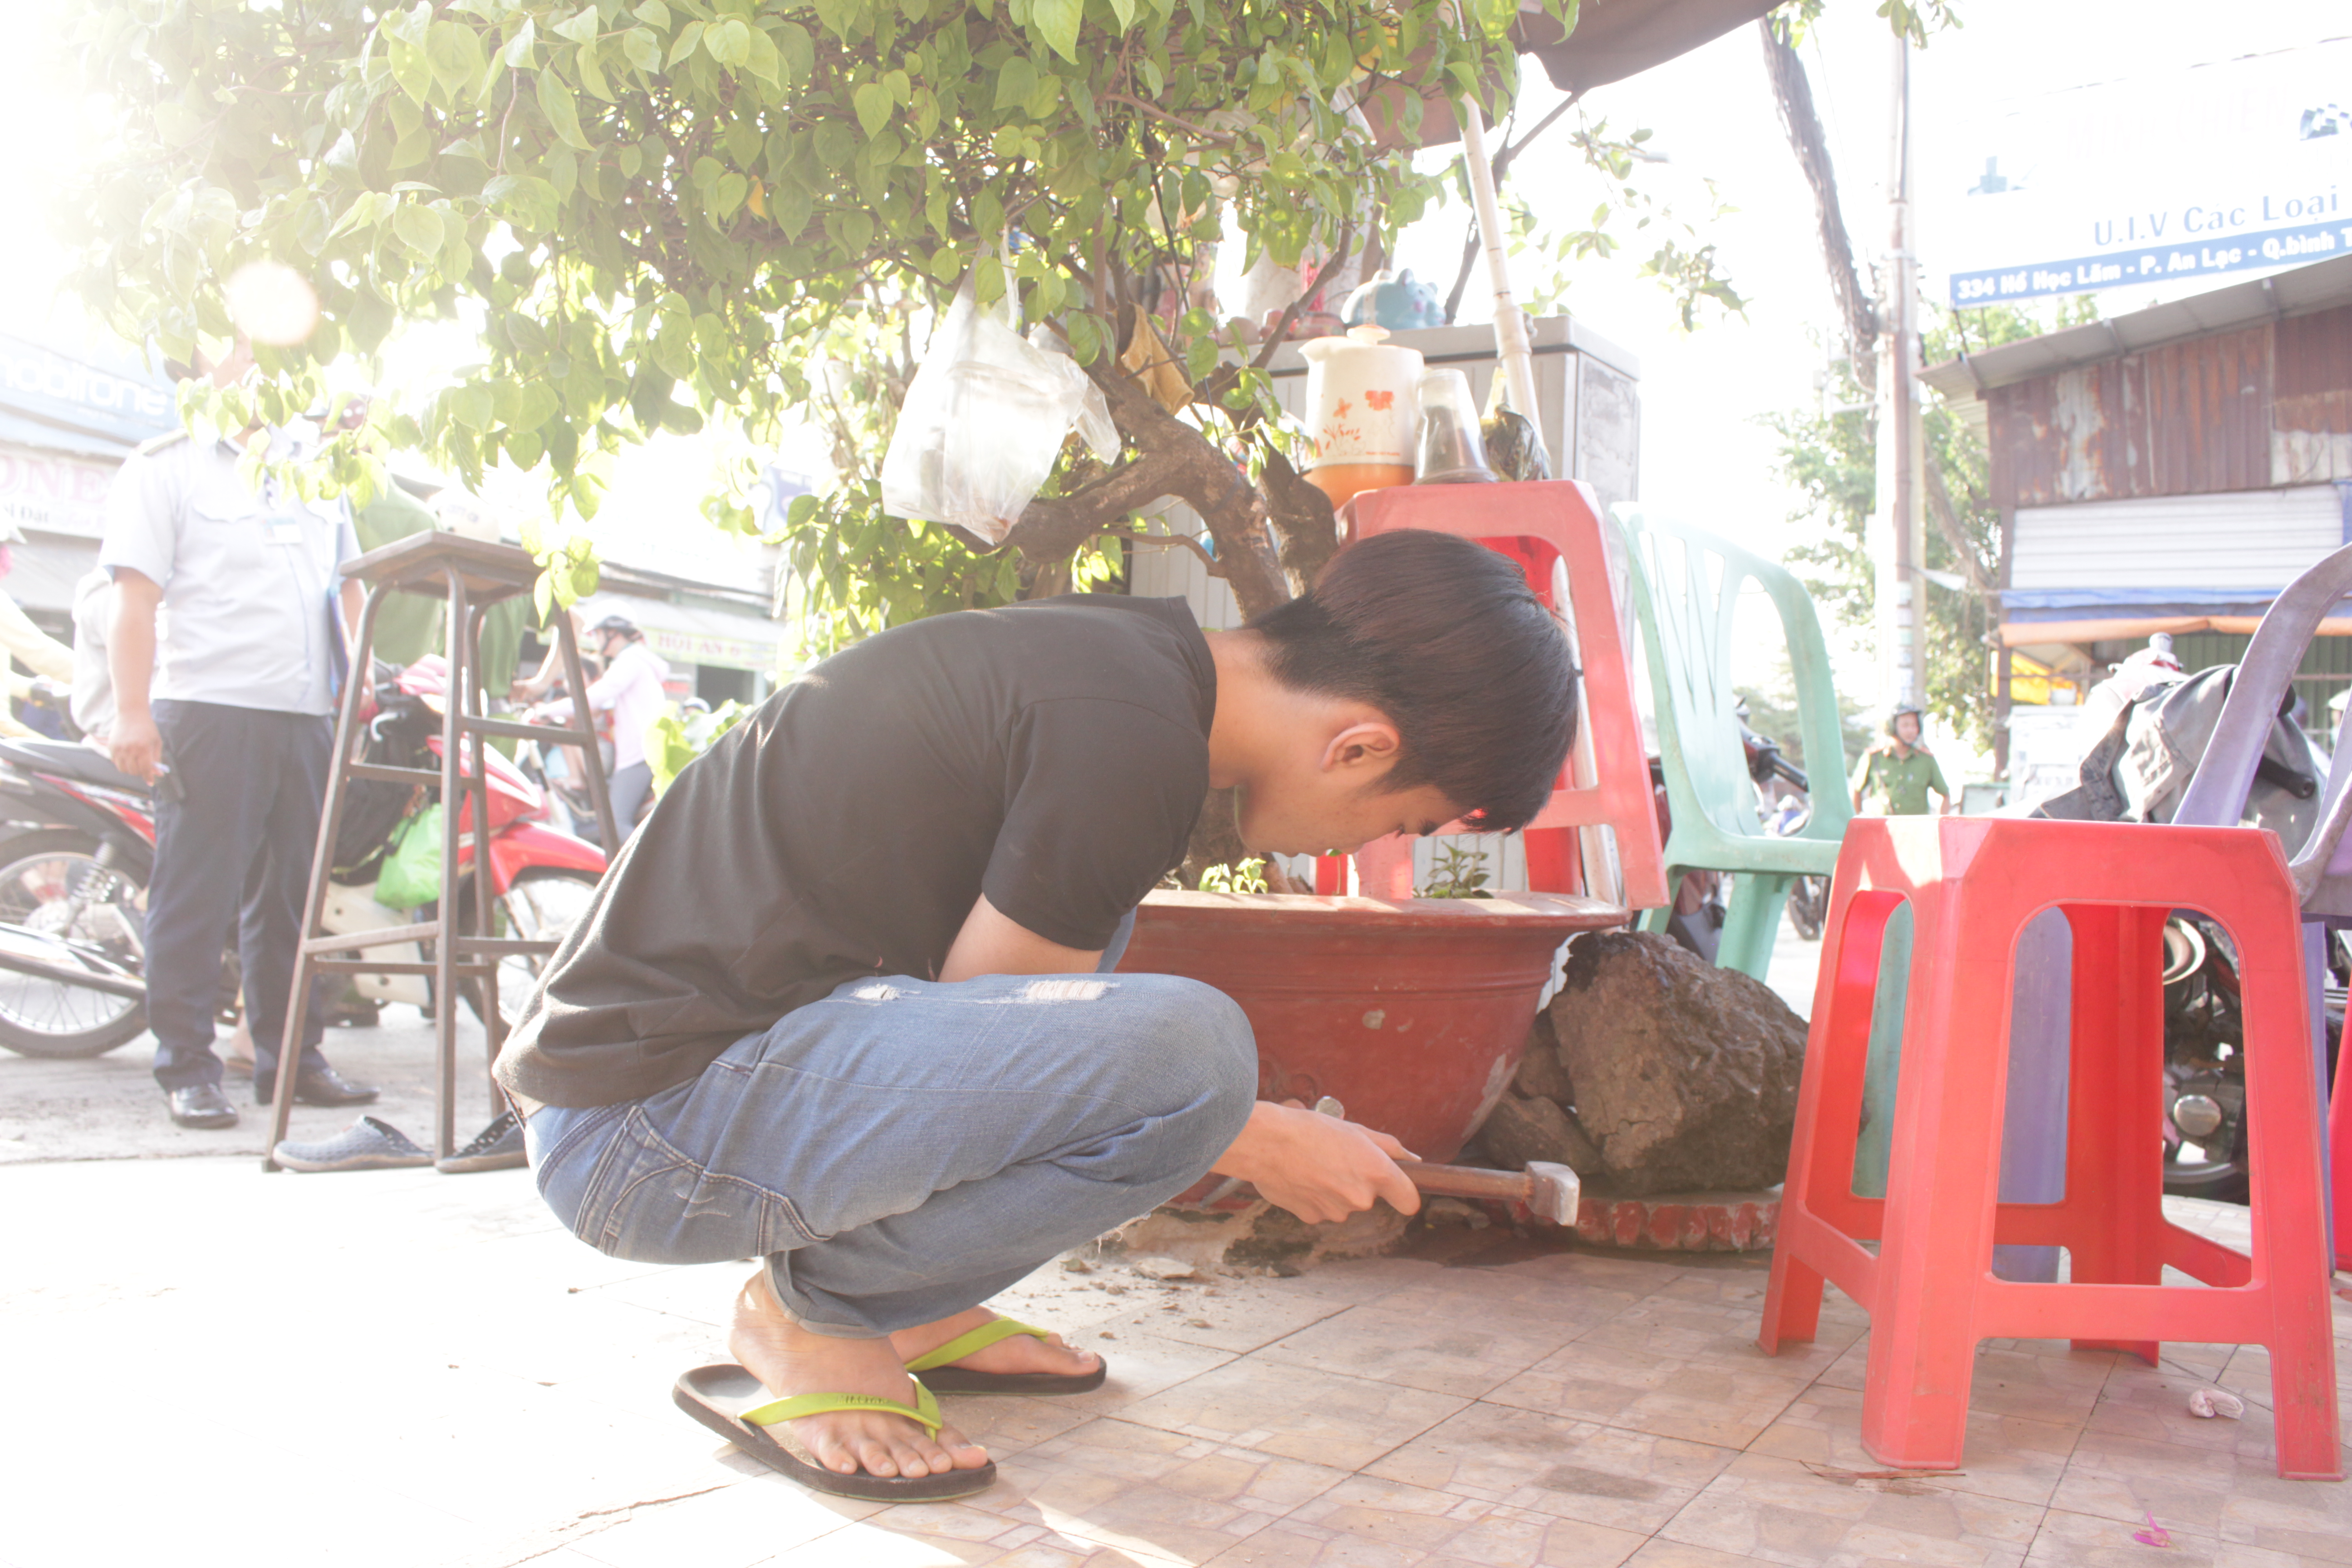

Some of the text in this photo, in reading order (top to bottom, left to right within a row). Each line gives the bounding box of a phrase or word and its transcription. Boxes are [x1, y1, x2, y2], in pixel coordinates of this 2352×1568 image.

[2095, 185, 2337, 246] U.I.V Các Loại
[1959, 277, 1994, 299] 334
[2167, 252, 2195, 272] An
[2201, 248, 2241, 269] Lạc
